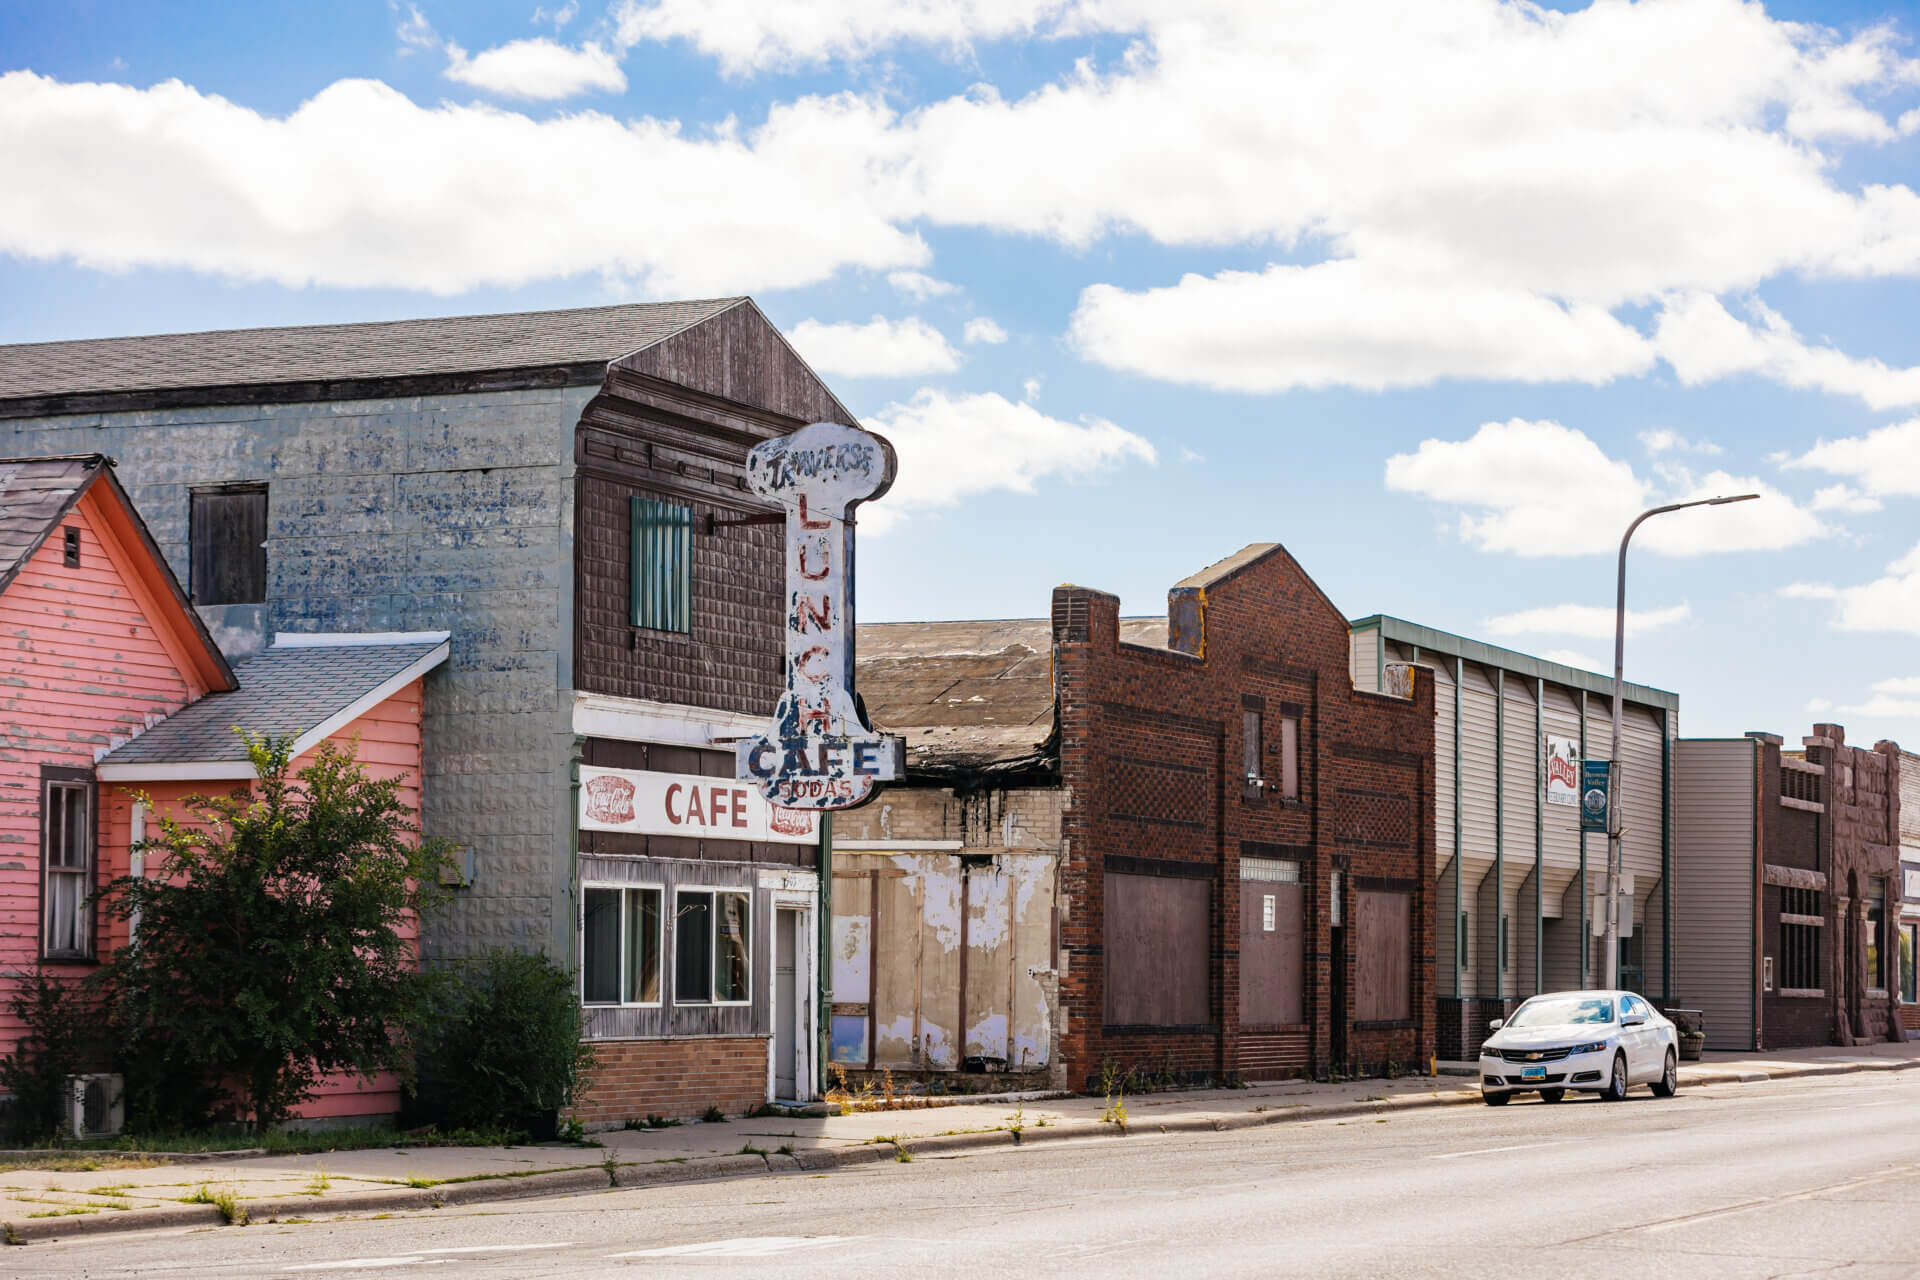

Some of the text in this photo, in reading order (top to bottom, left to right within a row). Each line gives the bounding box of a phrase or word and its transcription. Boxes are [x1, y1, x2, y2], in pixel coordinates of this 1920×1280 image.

[799, 493, 831, 733] LUNCH
[749, 743, 880, 777] CAFE
[1552, 760, 1575, 785] VALLEY
[665, 783, 748, 828] CAFE
[779, 780, 852, 798] SODAS
